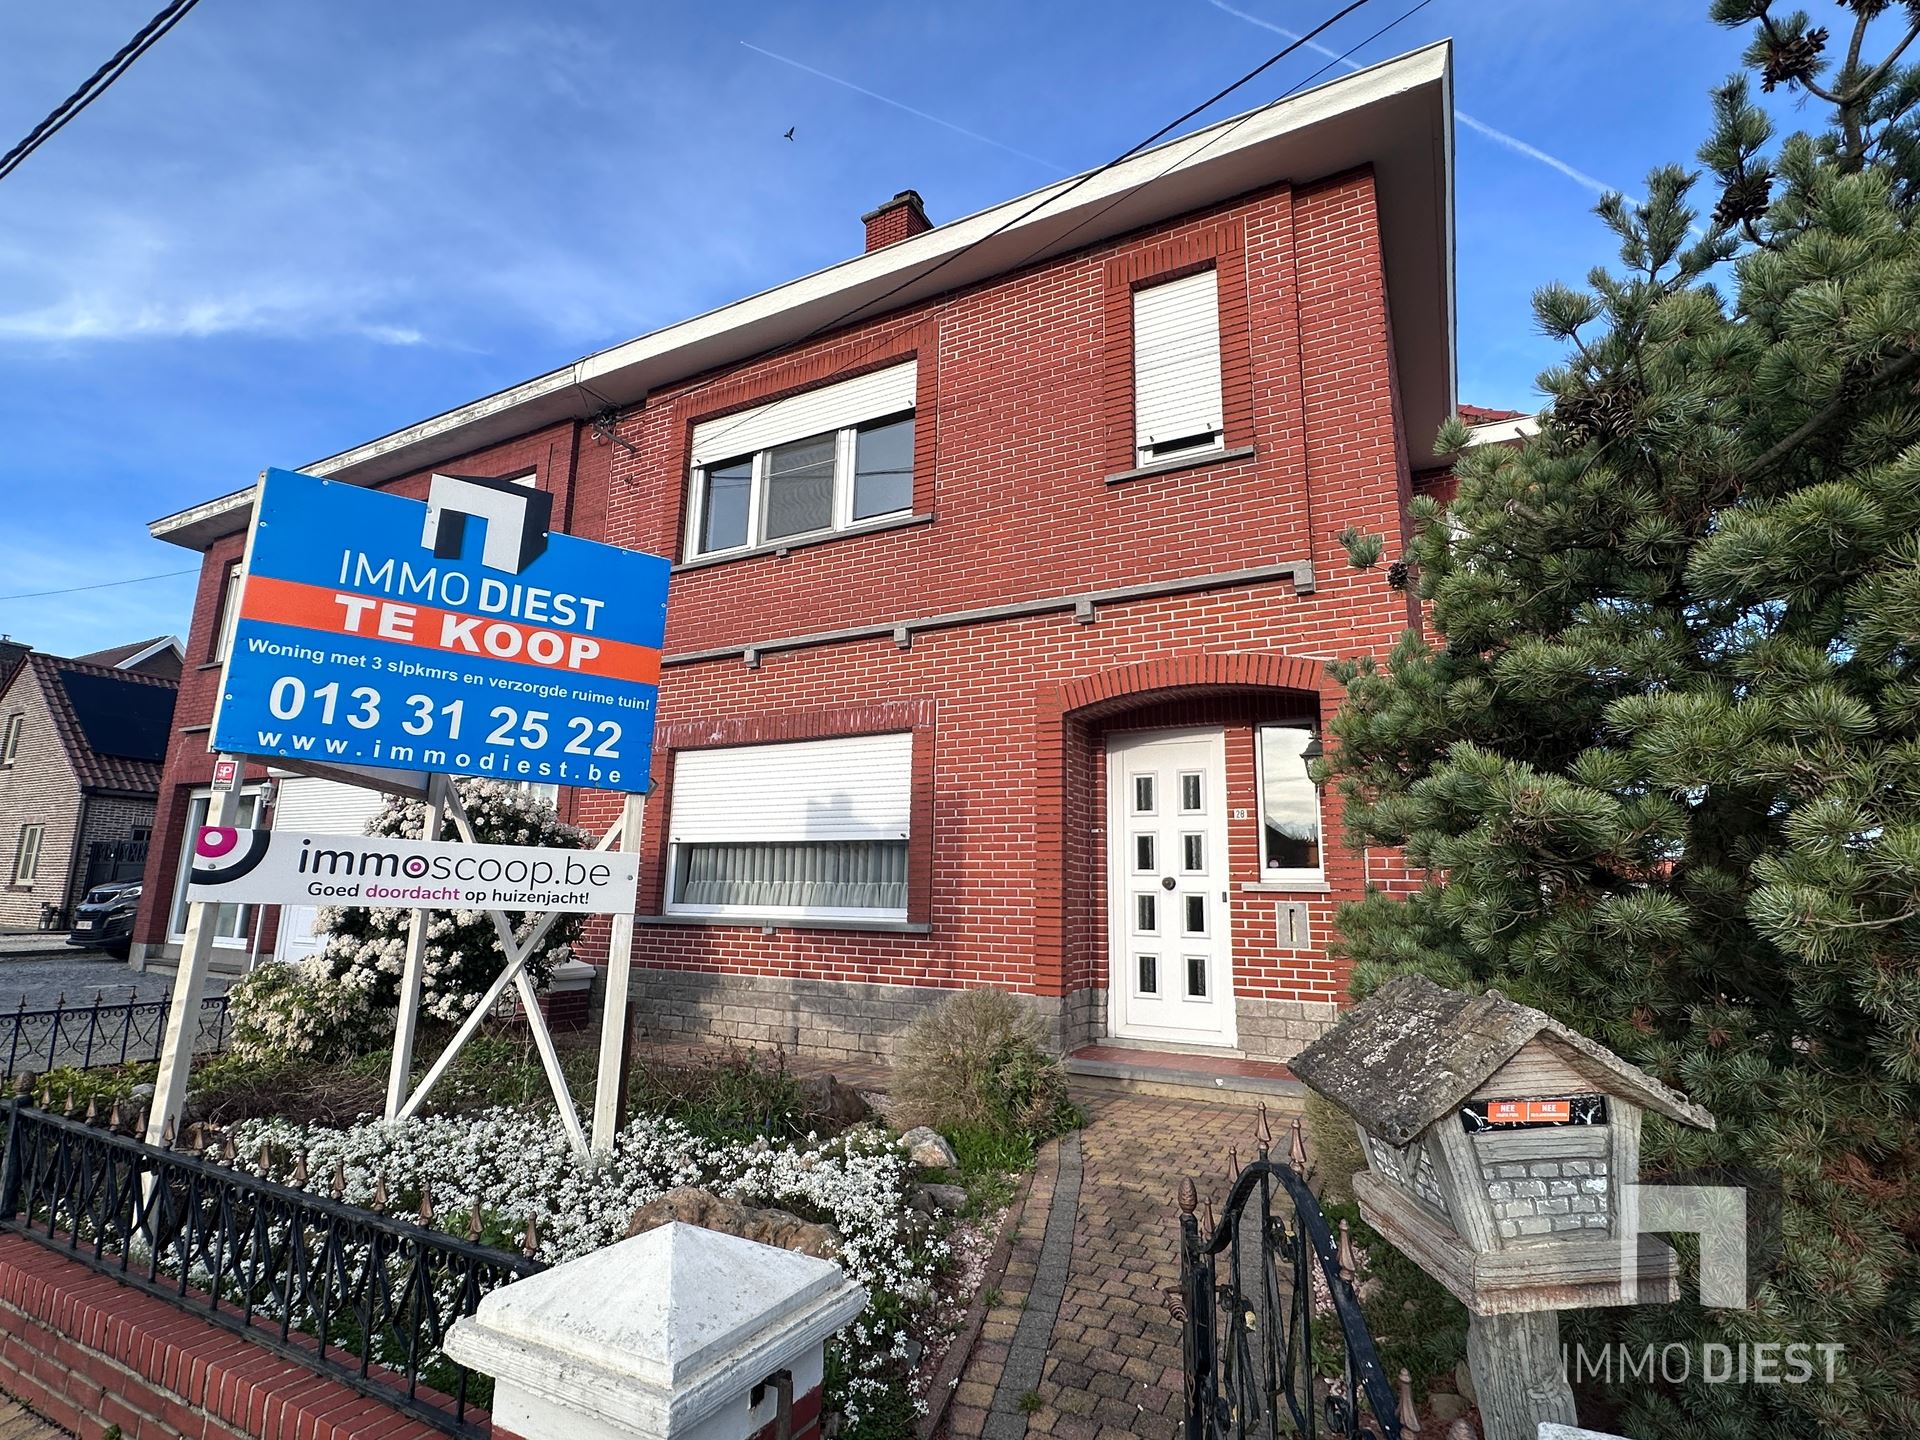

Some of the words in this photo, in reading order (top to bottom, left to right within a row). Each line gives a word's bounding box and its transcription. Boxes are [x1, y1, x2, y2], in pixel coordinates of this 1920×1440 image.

[339, 549, 470, 606] IMMO
[478, 578, 605, 631] DIEST
[335, 593, 417, 642] TE
[439, 613, 600, 669] KOOP
[248, 638, 325, 665] Woning
[330, 653, 367, 668] met
[371, 656, 382, 670] 3
[387, 660, 458, 681] slpkmrs
[463, 672, 484, 686] en
[489, 676, 568, 698] verzorgde
[572, 690, 614, 705] ruime
[618, 695, 650, 711] tuin!
[269, 676, 381, 730] 013
[401, 694, 464, 740] 31
[485, 706, 549, 750] 25
[563, 716, 622, 759] 22
[257, 731, 622, 784] www.immodiest.be
[1236, 809, 1245, 819] 28
[298, 838, 611, 891] immoscoop.be
[307, 880, 360, 898] Goed
[365, 885, 461, 901] doordacht
[464, 891, 487, 905] op
[492, 888, 590, 906] huizenjacht!
[1500, 1104, 1516, 1112] NEE
[1541, 1104, 1557, 1112] NEE
